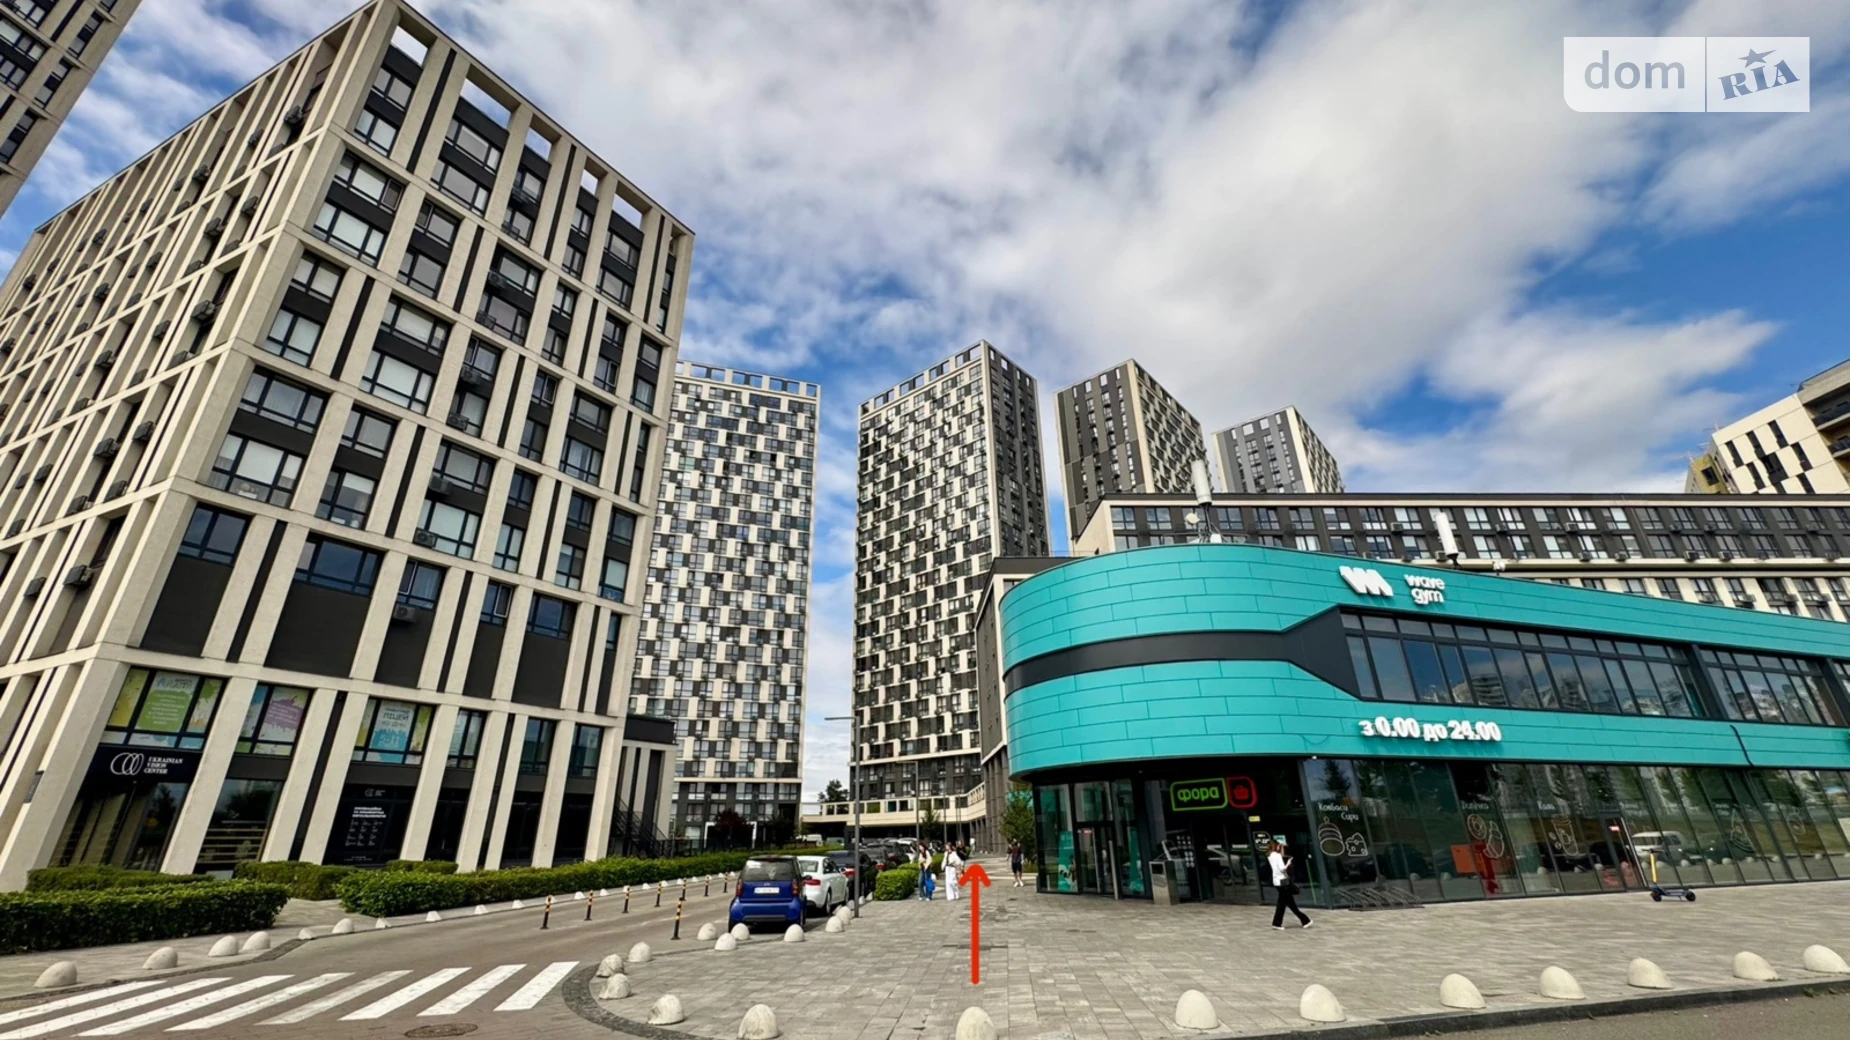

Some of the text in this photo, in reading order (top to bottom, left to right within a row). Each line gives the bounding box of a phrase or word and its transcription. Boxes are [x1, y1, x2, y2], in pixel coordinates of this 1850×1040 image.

[1404, 574, 1446, 590] wave
[1411, 588, 1445, 606] gym
[1374, 715, 1421, 739] 0.00
[1422, 722, 1449, 742] до
[1447, 719, 1502, 742] 24.00
[147, 756, 184, 764] UKRAINIAN
[143, 767, 169, 775] CENTER
[1177, 786, 1220, 803] фора
[1318, 802, 1349, 812] Ковбаси
[1340, 811, 1360, 823] Сири
